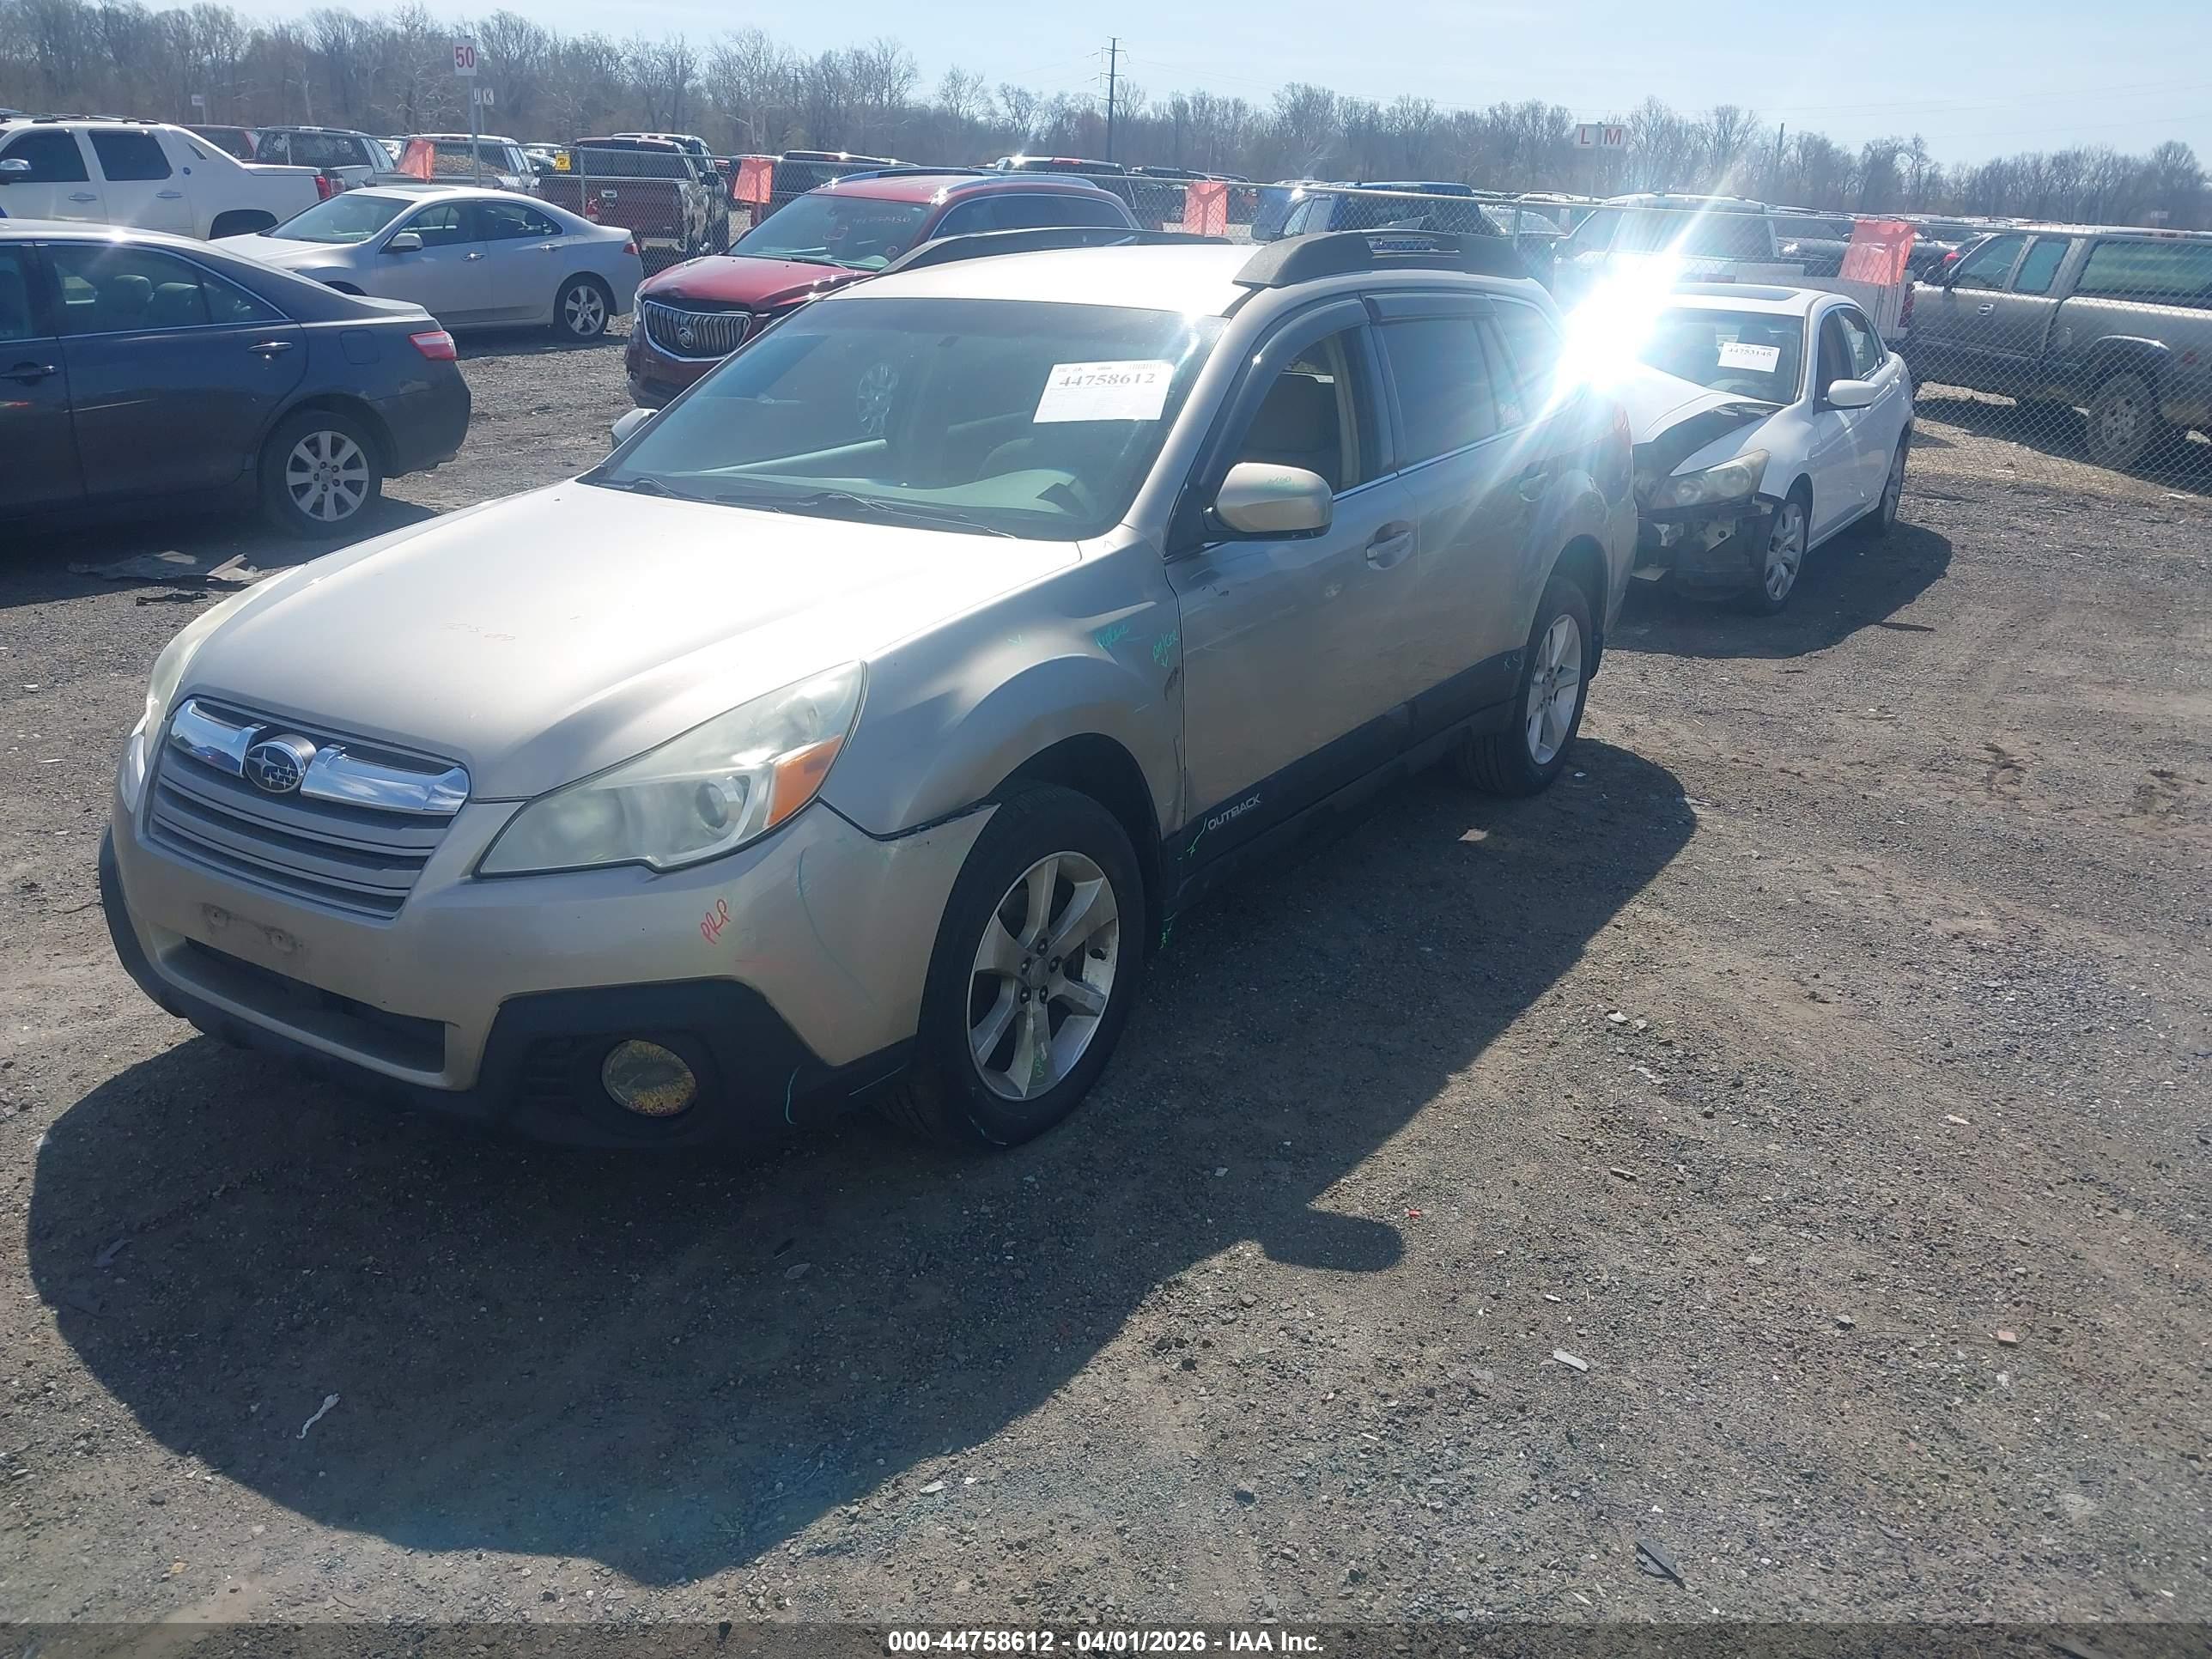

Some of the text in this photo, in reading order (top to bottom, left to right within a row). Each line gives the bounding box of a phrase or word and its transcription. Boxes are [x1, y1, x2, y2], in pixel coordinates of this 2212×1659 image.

[455, 46, 475, 68] 50
[485, 88, 493, 103] K
[1580, 128, 1622, 145] L M
[1059, 373, 1156, 387] 44758612
[1207, 793, 1261, 830] OUTBACK
